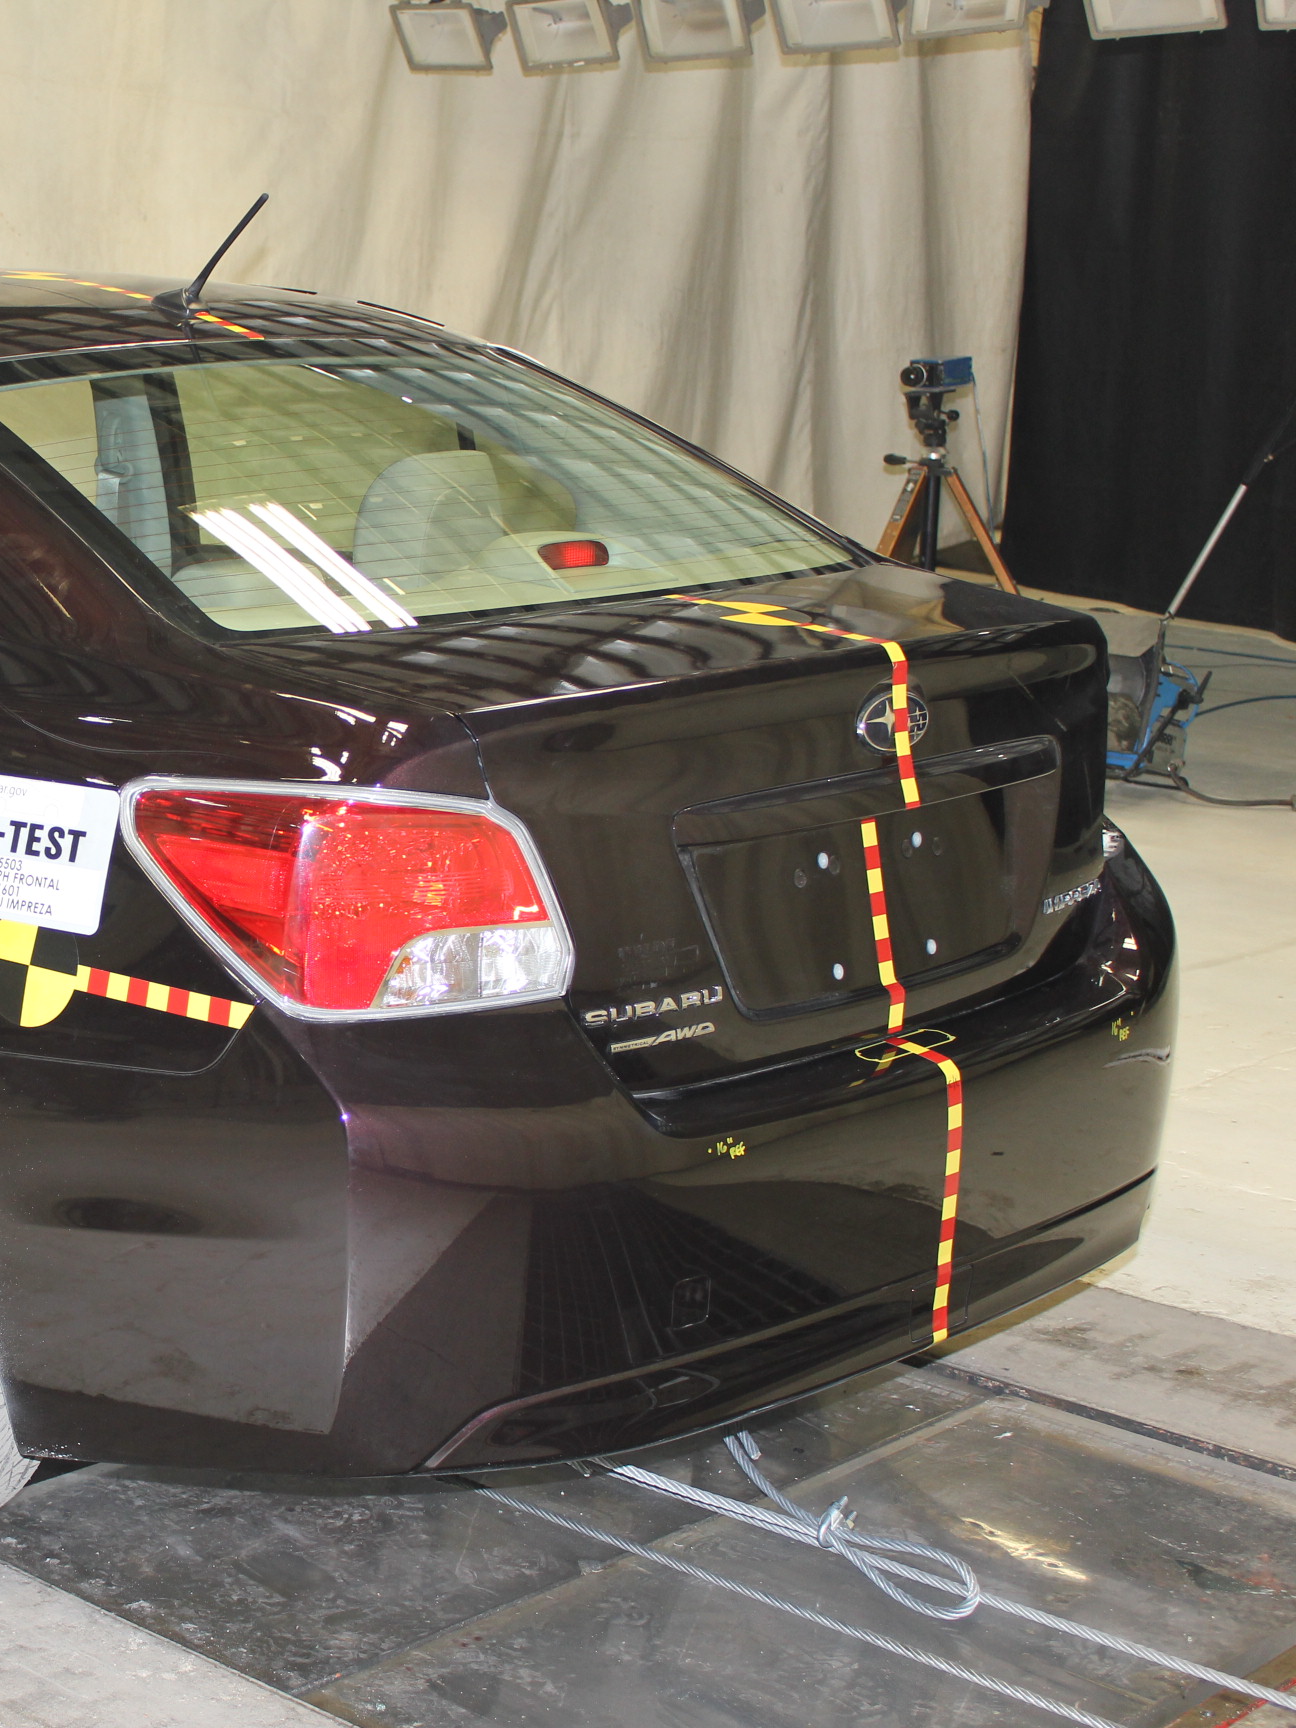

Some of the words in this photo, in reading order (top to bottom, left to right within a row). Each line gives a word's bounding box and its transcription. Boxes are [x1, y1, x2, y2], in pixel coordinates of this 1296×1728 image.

[13, 873, 60, 891] FRONTAL
[6, 898, 53, 916] IMPREZA
[585, 985, 723, 1026] SUBARU
[652, 1022, 716, 1046] AWD
